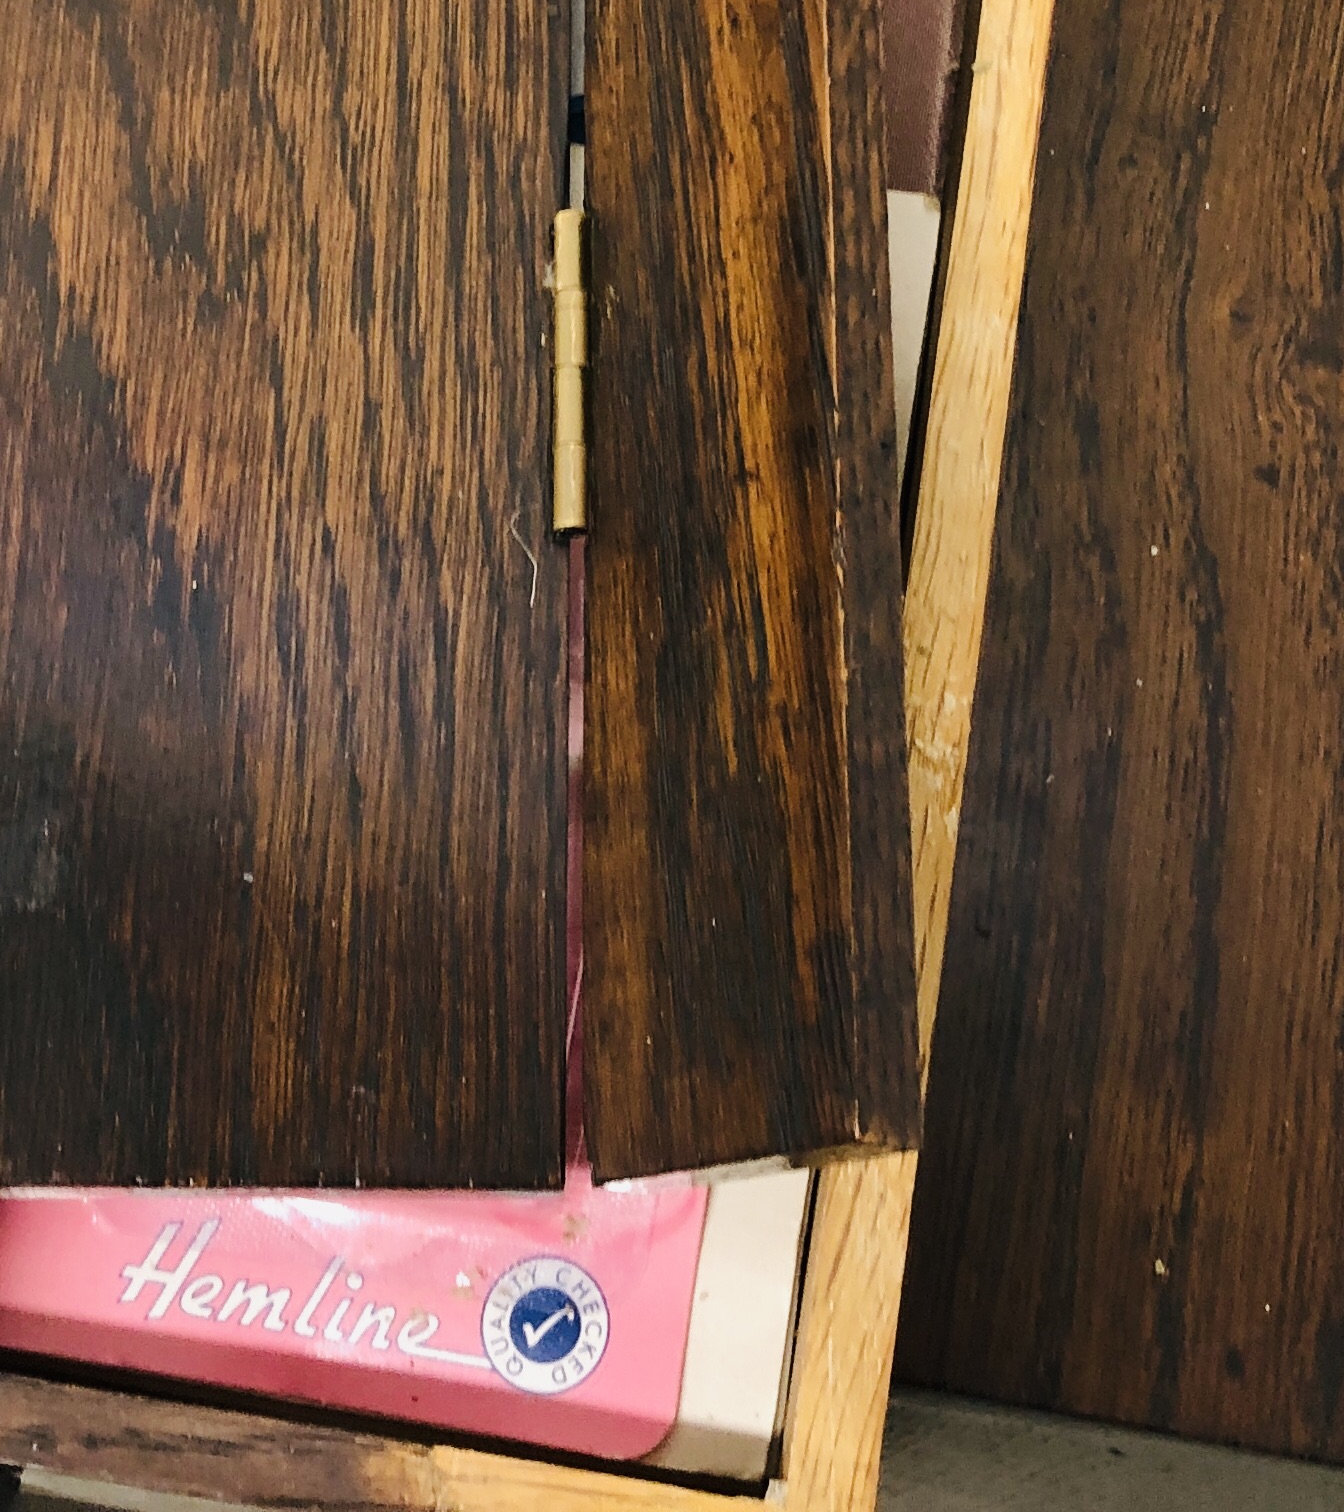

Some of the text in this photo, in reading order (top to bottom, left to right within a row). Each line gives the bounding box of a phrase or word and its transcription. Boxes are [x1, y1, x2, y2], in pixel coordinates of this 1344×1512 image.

[119, 1217, 493, 1370] Hemline
[490, 1265, 602, 1384] QUALITY CHECKED
